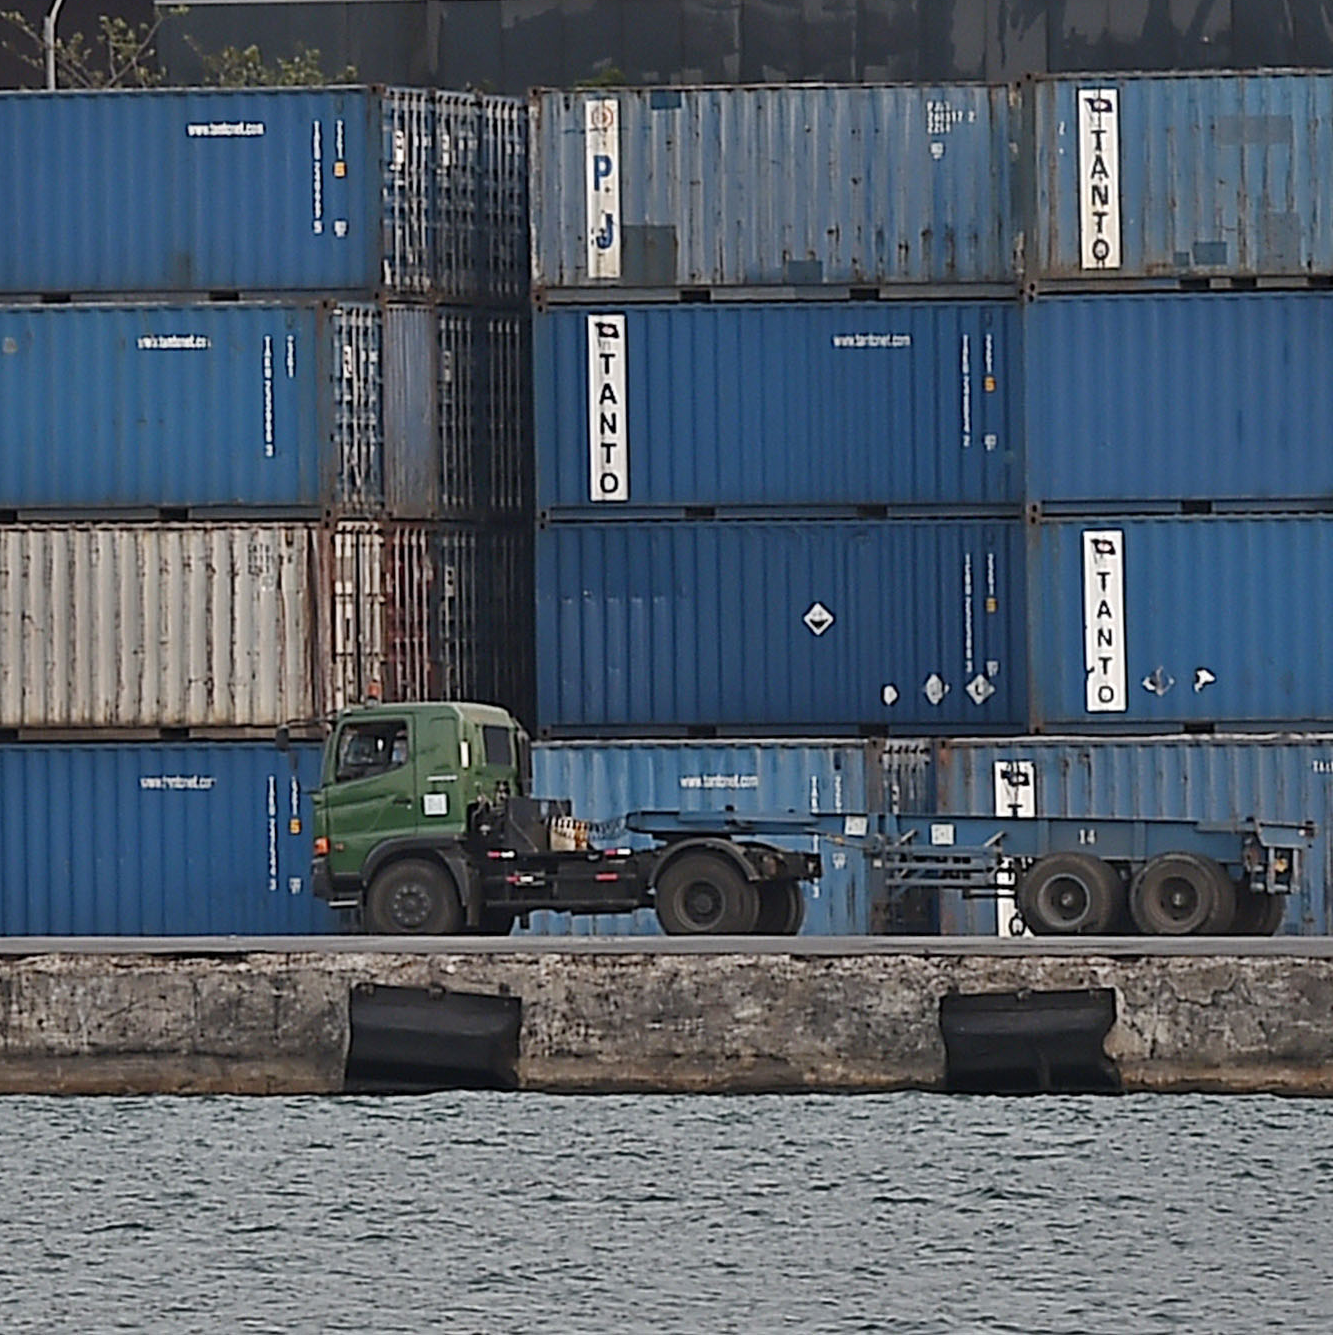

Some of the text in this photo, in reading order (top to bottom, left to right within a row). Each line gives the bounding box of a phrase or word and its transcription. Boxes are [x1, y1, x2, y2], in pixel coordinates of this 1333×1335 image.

[1090, 129, 1109, 260] TANTO
[598, 352, 619, 494] TANTO
[1096, 571, 1115, 704] TANTO
[1079, 828, 1096, 845] 14
